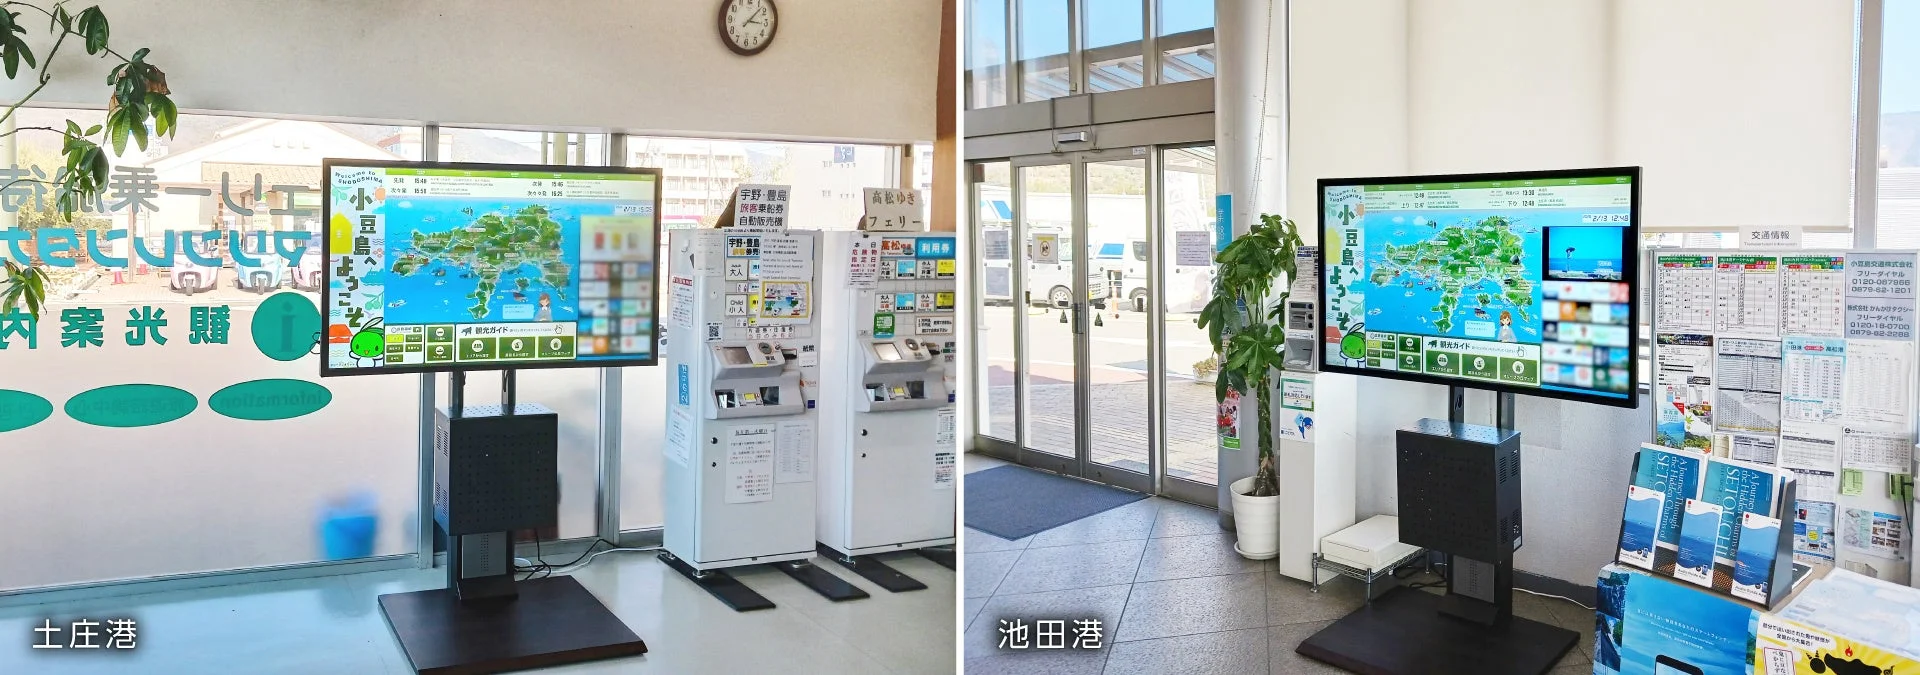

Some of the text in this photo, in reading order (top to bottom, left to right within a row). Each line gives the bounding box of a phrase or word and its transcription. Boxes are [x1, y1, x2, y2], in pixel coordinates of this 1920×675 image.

[732, 5, 737, 13] 10
[762, 7, 767, 16] 2
[728, 15, 732, 24] 9
[764, 18, 768, 27] 3
[730, 26, 735, 35] 8
[760, 29, 765, 37] 4
[735, 35, 740, 44] 7
[743, 38, 749, 46] 6
[753, 36, 758, 45] 5
[740, 189, 787, 201] 宇野・豊島
[872, 190, 916, 205] 高松ゆき
[740, 203, 783, 213] 旅客乗船券
[739, 216, 783, 226] 自動販売機
[868, 215, 921, 228] フェリー
[1611, 214, 1629, 222] 12:48
[1751, 230, 1790, 240] 交通情報
[728, 238, 760, 247] 宇野・豊島
[921, 243, 950, 253] 利用券
[1850, 260, 1913, 268] 小豆島交通株式会社
[475, 326, 508, 335] 観光ガイド
[1440, 341, 1471, 351] 観光ガイド
[1742, 470, 1750, 482] the
[1668, 469, 1679, 499] Hidden
[1677, 466, 1688, 498] Journey
[1748, 472, 1760, 512] A Journey
[1738, 482, 1750, 513] Hidden
[1662, 499, 1674, 530] Charms
[1671, 495, 1684, 529] Through
[1715, 466, 1740, 556] SETOUCHI
